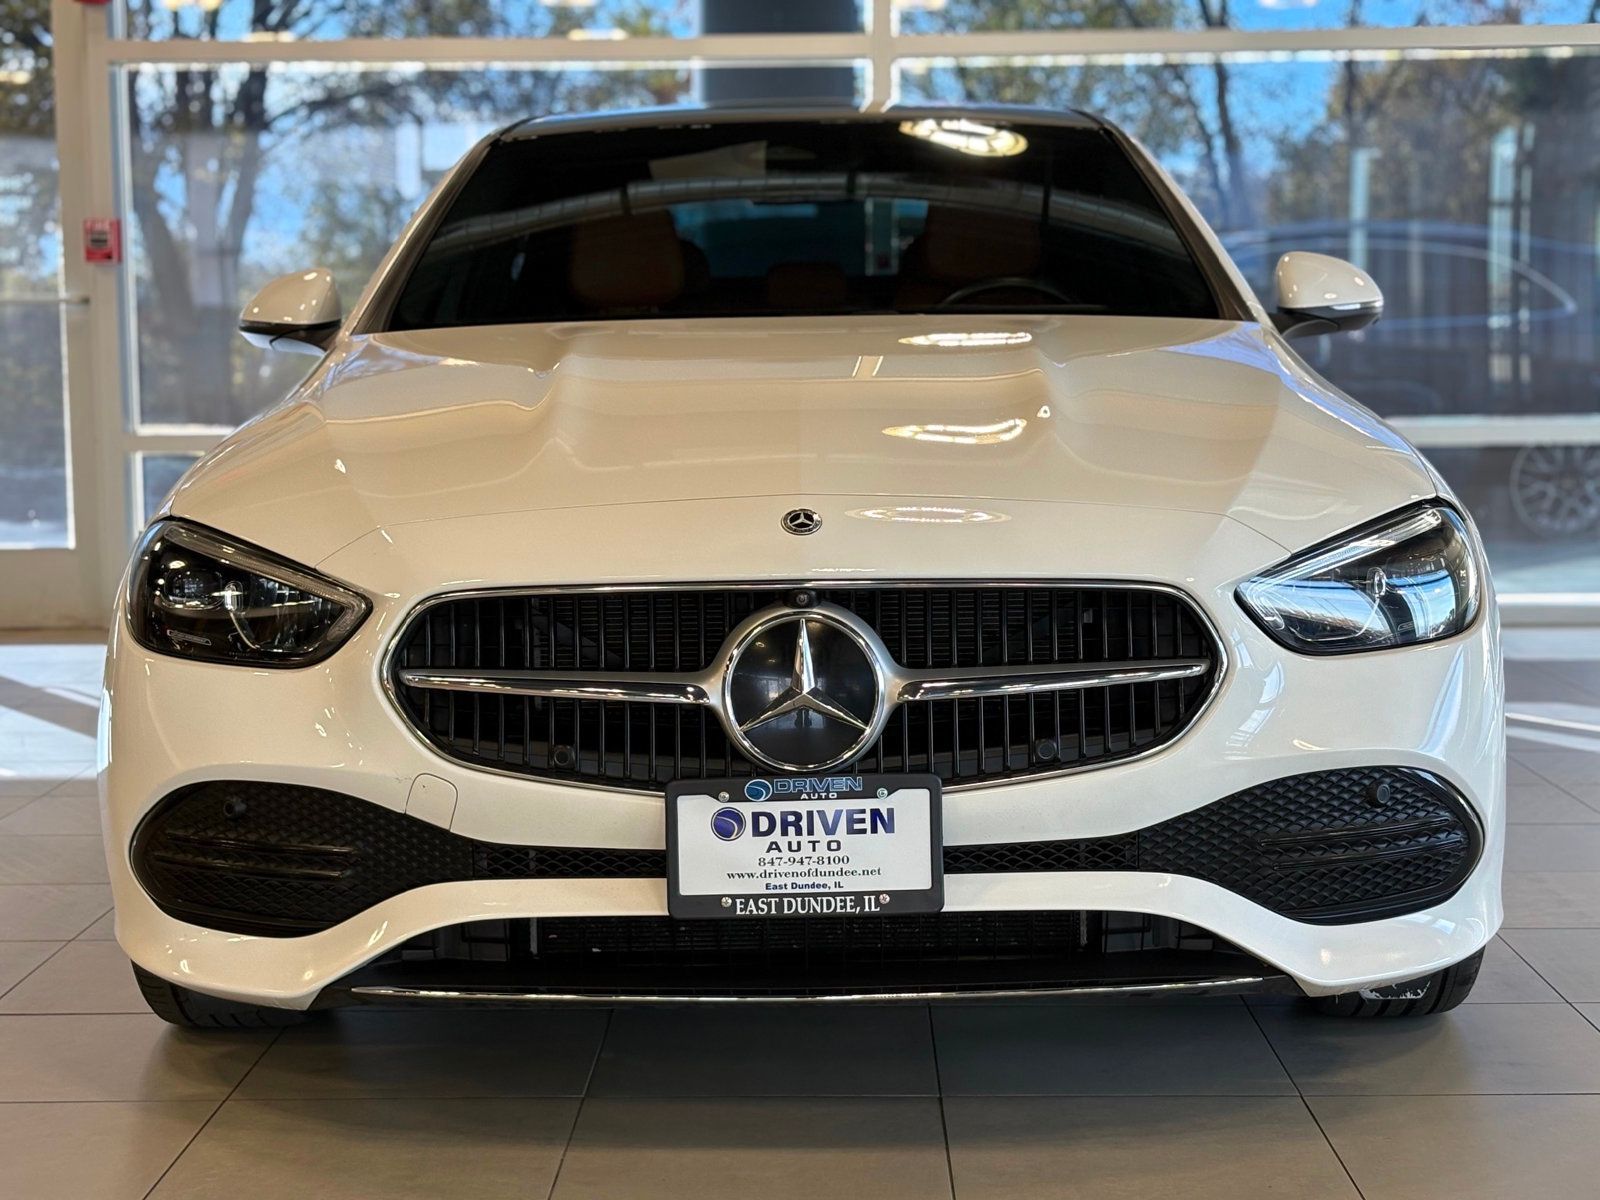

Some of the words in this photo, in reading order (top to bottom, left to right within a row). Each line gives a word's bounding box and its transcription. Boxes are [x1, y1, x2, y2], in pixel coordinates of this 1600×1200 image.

[774, 777, 863, 793] DRIVEN
[800, 792, 838, 800] AUTO
[751, 807, 896, 838] DRIVEN
[765, 840, 843, 854] AUTO
[758, 855, 850, 867] 847-947-8100
[726, 867, 882, 880] www.drivenofdundee.net
[765, 882, 788, 891] East
[791, 881, 831, 891] Dundee,
[834, 881, 844, 889] IL
[735, 898, 780, 915] EAST
[783, 896, 861, 914] DUNDEE,
[864, 895, 881, 912] IL
